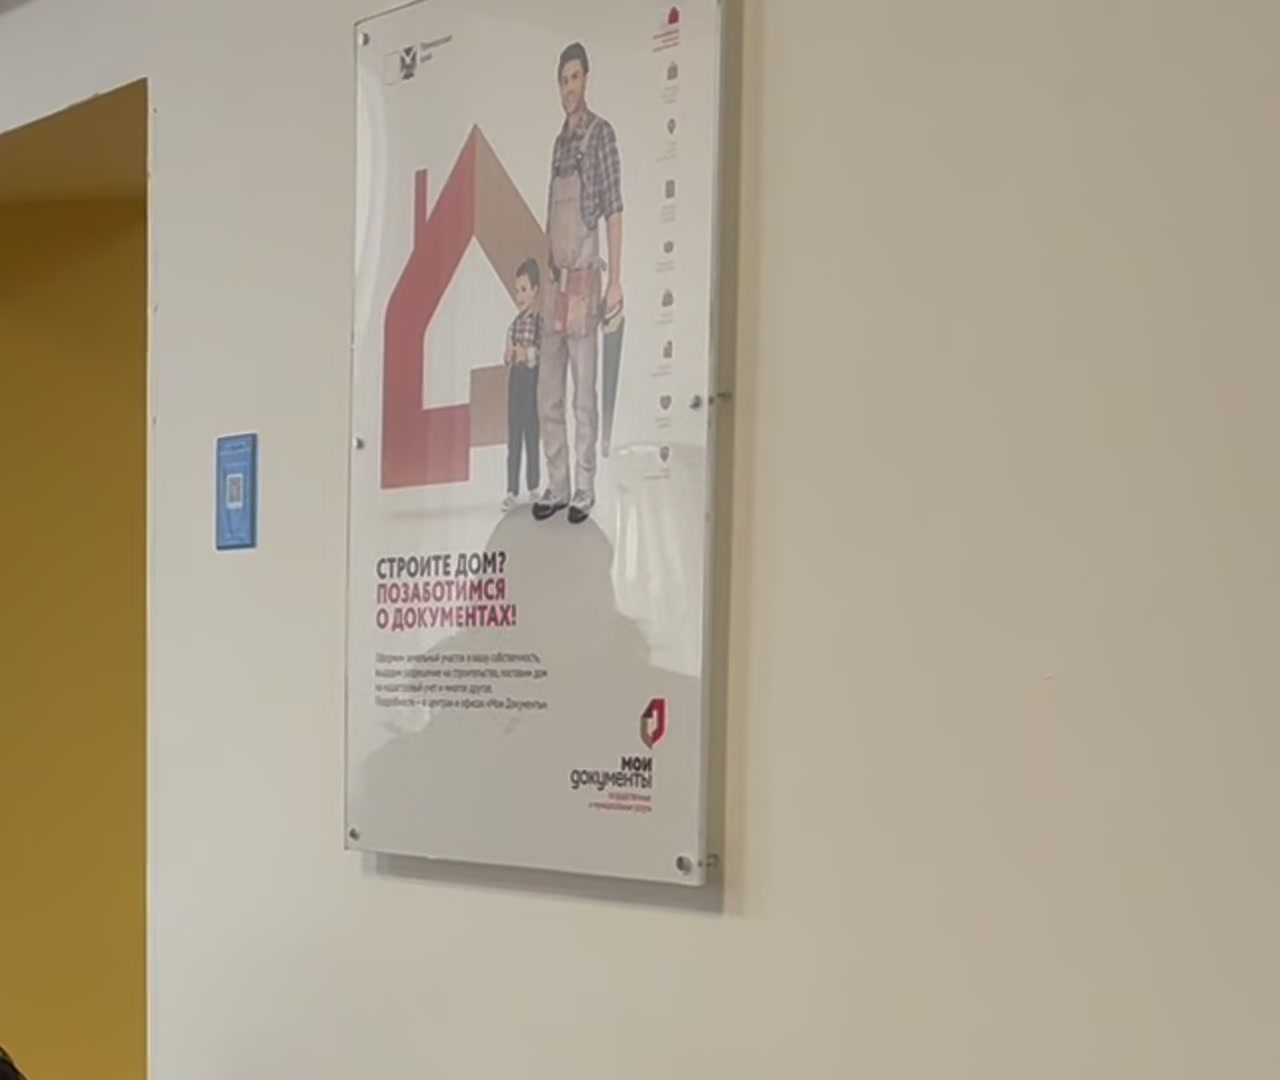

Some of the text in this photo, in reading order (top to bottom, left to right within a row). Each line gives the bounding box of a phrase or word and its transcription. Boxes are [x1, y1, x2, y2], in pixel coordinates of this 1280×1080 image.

[376, 551, 507, 579] СТРОИТЕ ДОМ?
[376, 578, 506, 604] ПОЗАБОТИМСЯ
[376, 604, 517, 632] О ДОКУМЕНТАХ!
[570, 769, 653, 791] документы
